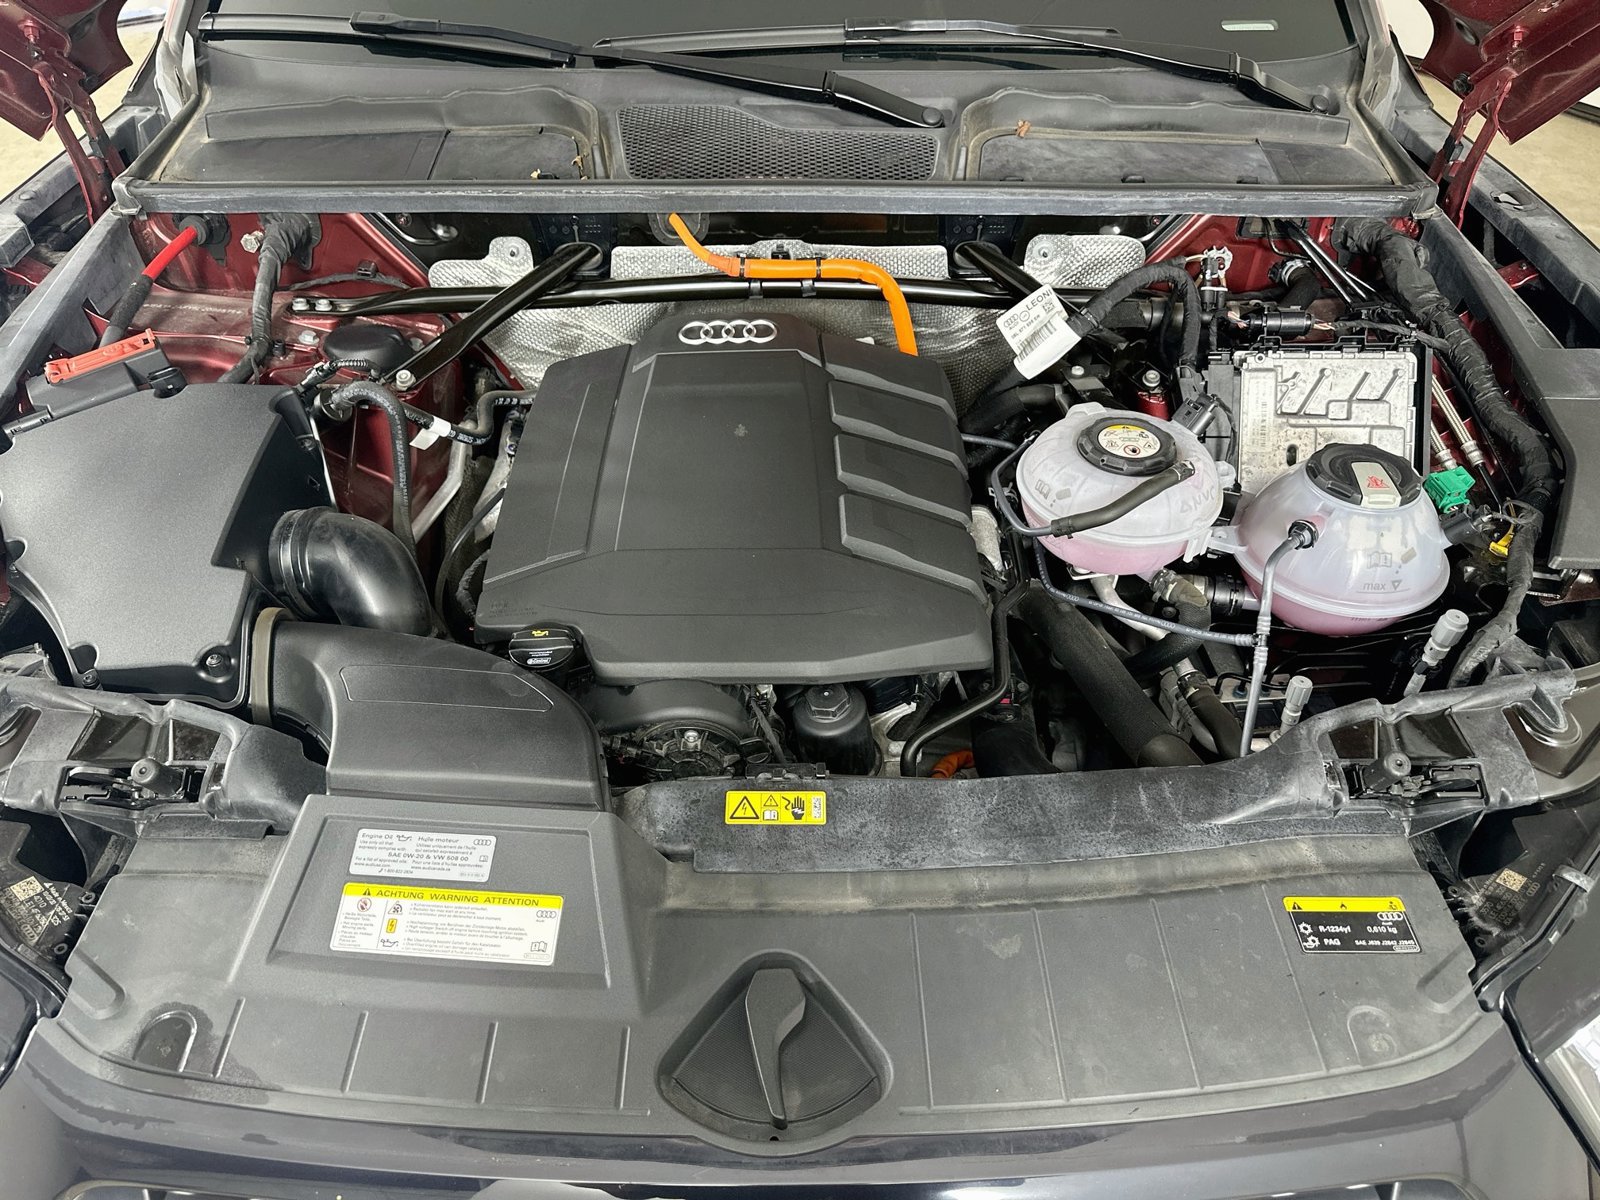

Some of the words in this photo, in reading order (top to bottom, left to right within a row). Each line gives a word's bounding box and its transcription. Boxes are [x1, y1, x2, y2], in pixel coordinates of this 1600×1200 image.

[1026, 289, 1052, 310] LEONI
[1363, 582, 1386, 590] max
[376, 889, 424, 900] ACHTUNG
[430, 893, 479, 904] WARNING
[484, 896, 540, 906] ATTENTION
[1387, 926, 1398, 934] kg
